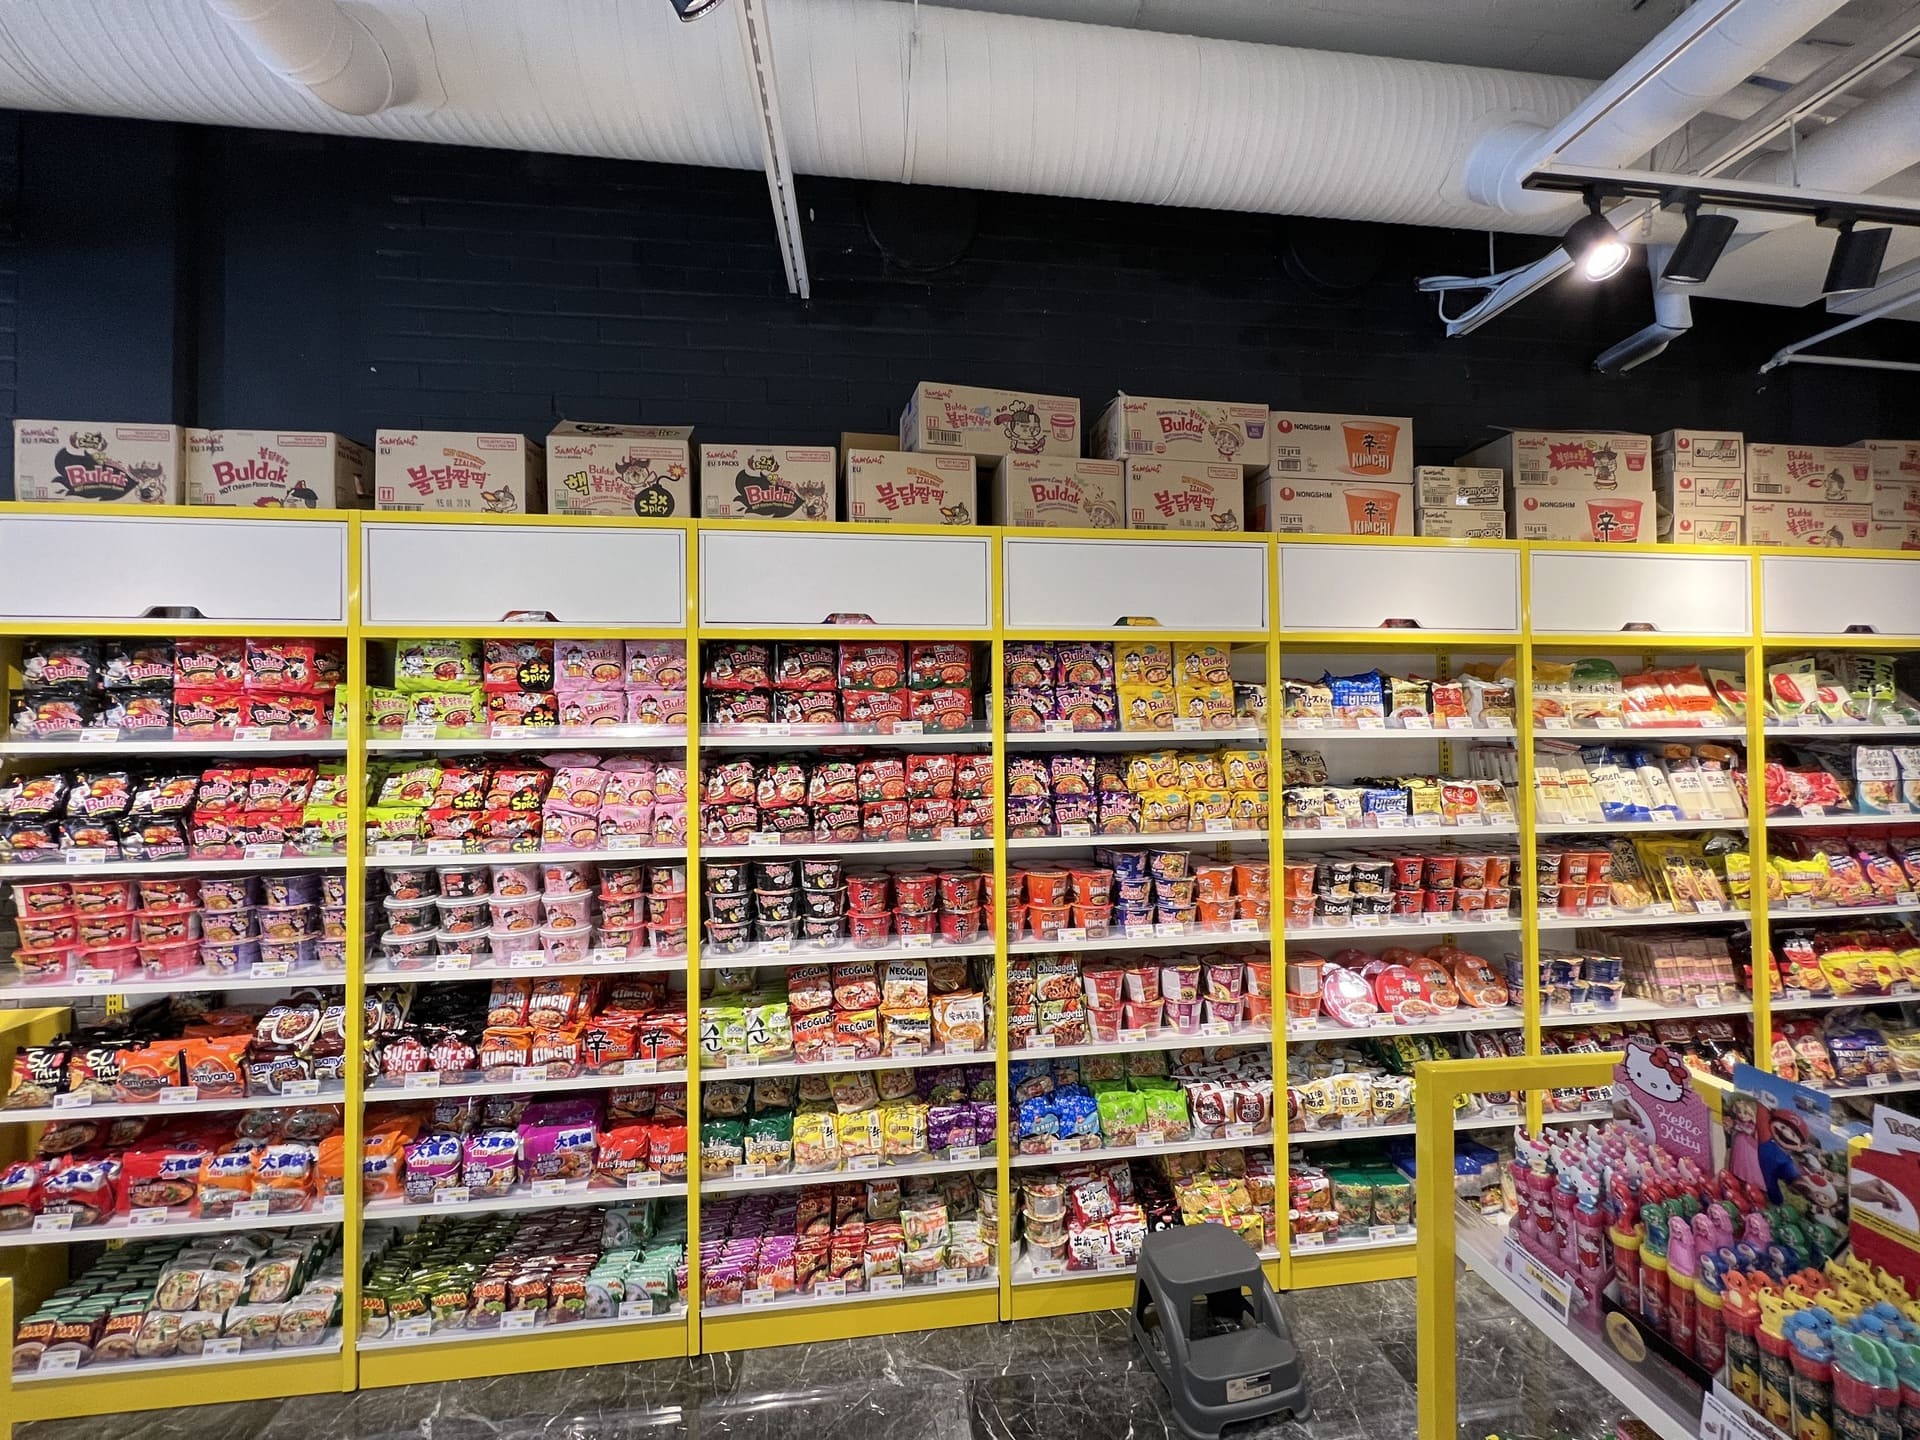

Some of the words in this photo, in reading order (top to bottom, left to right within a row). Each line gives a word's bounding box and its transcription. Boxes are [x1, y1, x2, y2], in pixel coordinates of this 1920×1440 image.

[1159, 417, 1204, 434] Buldak
[1294, 423, 1330, 431] NONGSHIM
[555, 444, 596, 456] SAMYANG
[1352, 453, 1389, 469] KIMCHI
[65, 465, 128, 487] Buldak
[213, 460, 287, 486] Buldak
[219, 486, 232, 495] HOT
[564, 471, 590, 496] 핵
[648, 491, 668, 505] 3x
[744, 485, 796, 504] Buldak
[1031, 485, 1080, 504] Buldak
[640, 501, 668, 514] Spicy
[1354, 520, 1390, 536] KIMCHI
[1597, 511, 1619, 542] 辛
[730, 651, 768, 664] Buldak
[800, 652, 835, 664] Buldak
[867, 655, 898, 666] Buldak
[936, 651, 968, 663] Buldak
[1061, 652, 1093, 665] Buldak
[530, 662, 550, 674] 3x
[520, 669, 551, 683] Spicy
[801, 694, 835, 709] Buldak
[871, 700, 902, 711] Buldak
[935, 697, 965, 709] Buldak
[1058, 693, 1093, 706] Buldak
[732, 700, 768, 714] Buldak
[85, 797, 128, 812] Buldak
[723, 812, 757, 827] Buldak
[1325, 905, 1349, 913] UDON
[1374, 904, 1392, 912] UDO
[790, 967, 830, 981] NEOGURI
[837, 964, 873, 977] NEOGURI
[889, 965, 926, 977] NEOGURI
[1037, 962, 1078, 975] Chapagetti
[489, 992, 525, 1008] KIMCHI
[529, 994, 571, 1009] KIMCHI
[1042, 1010, 1085, 1020] Chapagetti
[748, 1016, 769, 1043] 순
[796, 1015, 834, 1031] NEOGURI
[838, 1021, 875, 1033] NEOGURI
[641, 1026, 669, 1059] 辛
[700, 1024, 722, 1052] 순
[383, 1045, 425, 1060] SUPER
[429, 1045, 475, 1060] SUPER
[587, 1027, 612, 1065] 辛
[482, 1049, 527, 1067] KIMCHI
[532, 1045, 577, 1063] KIMCHI
[387, 1059, 420, 1071] SPICY
[433, 1058, 466, 1070] SPICY
[1656, 1103, 1703, 1135] Hello
[1661, 1124, 1700, 1153] Kitty
[1079, 1186, 1108, 1204] 出前一丁
[1074, 1233, 1109, 1247] 出前一丁
[871, 1251, 897, 1262] MAMA
